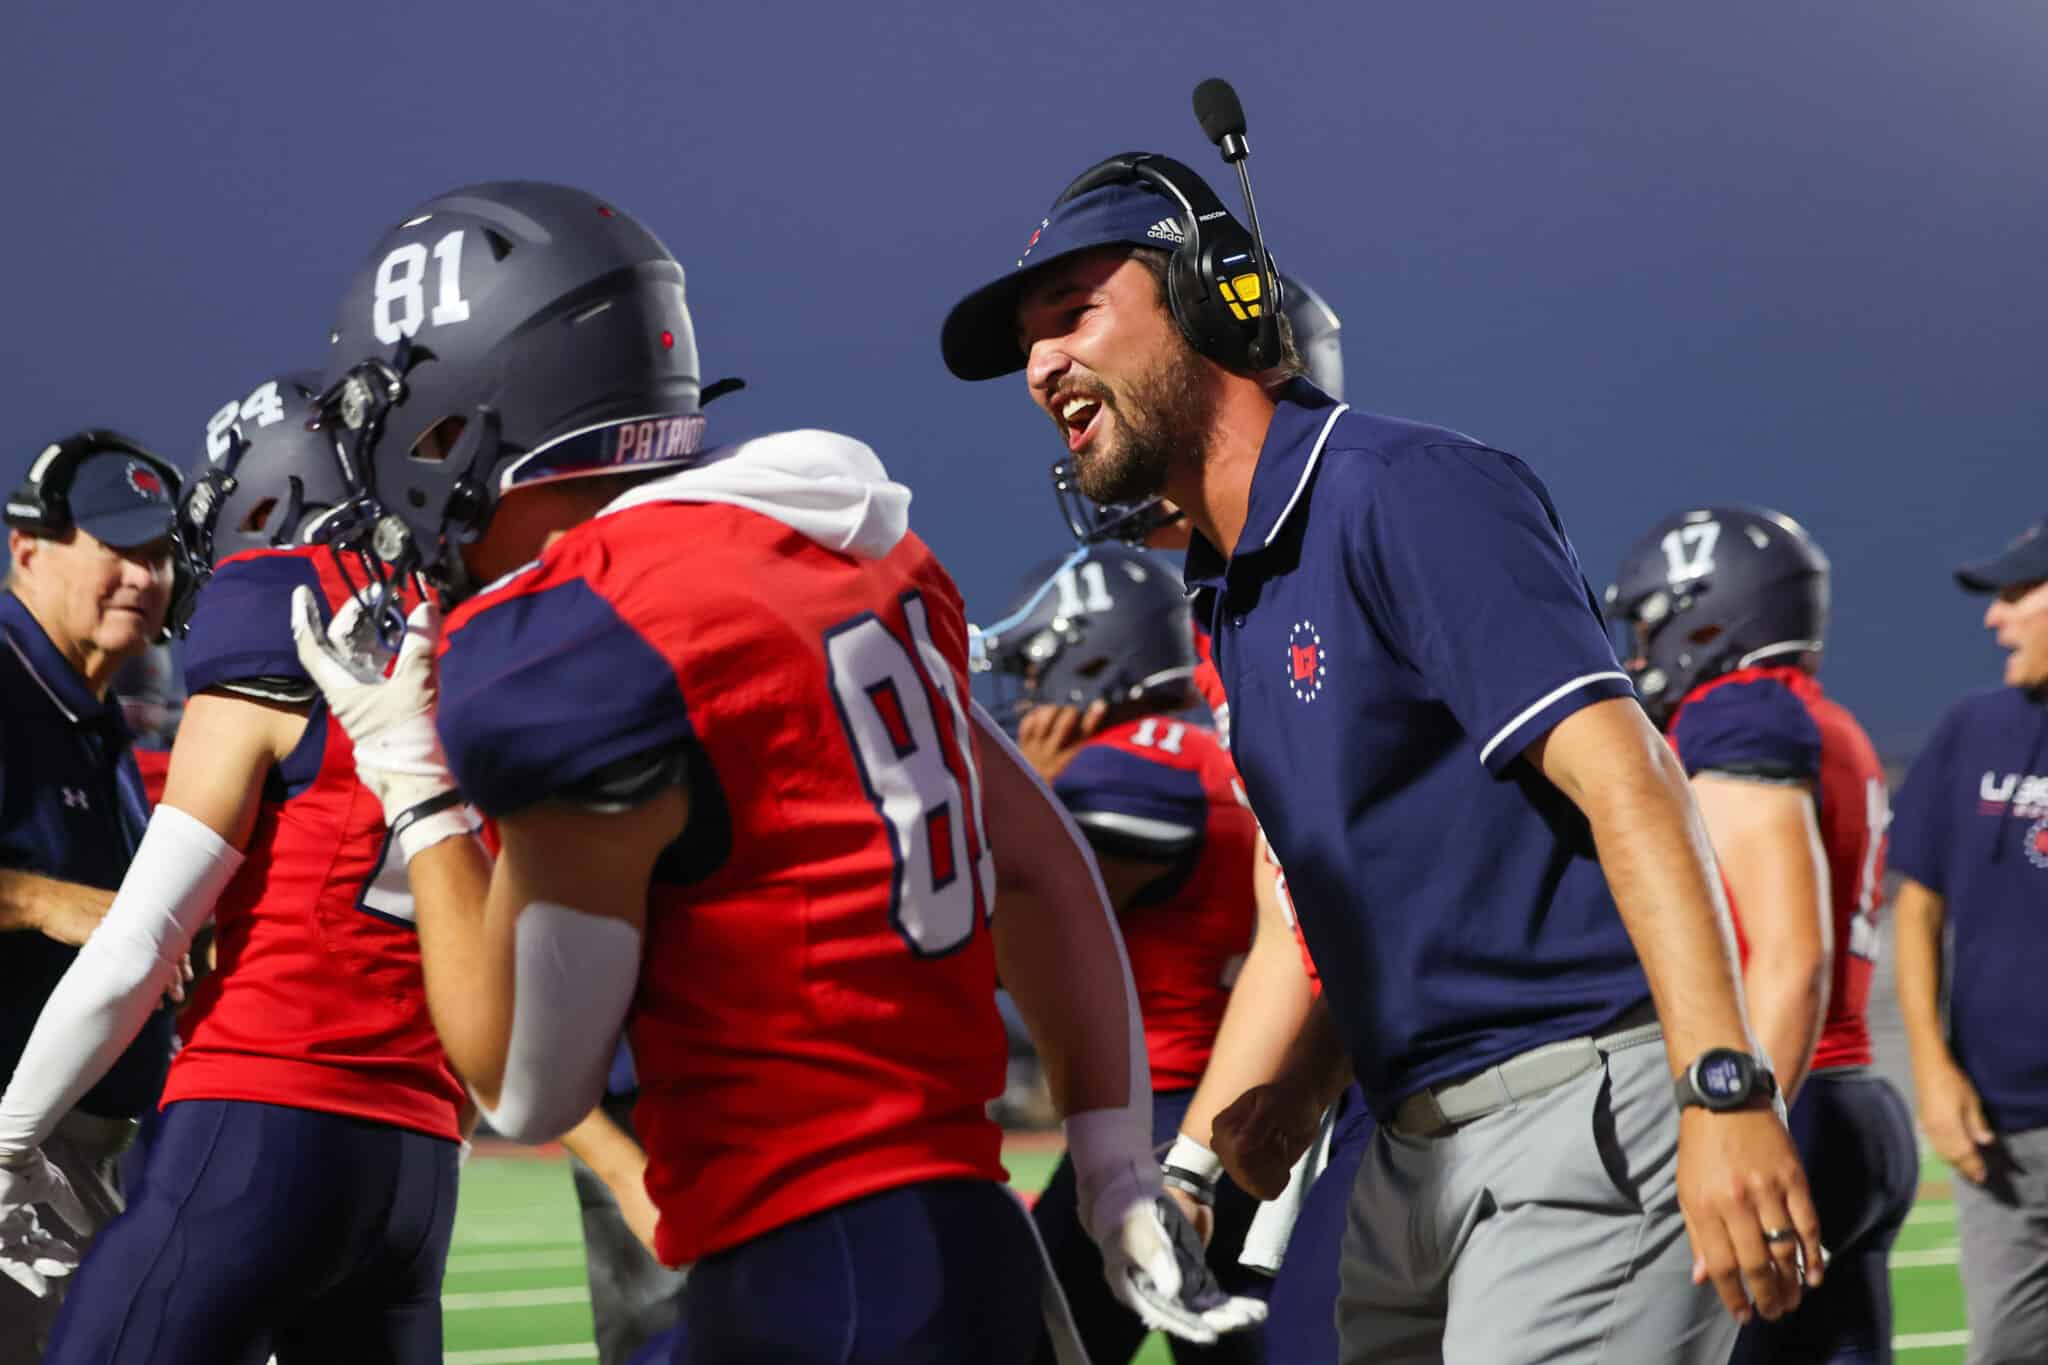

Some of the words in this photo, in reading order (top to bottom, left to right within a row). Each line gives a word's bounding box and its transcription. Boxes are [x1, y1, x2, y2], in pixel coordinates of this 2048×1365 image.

[373, 230, 470, 345] 81
[206, 380, 285, 462] 24
[1661, 520, 1721, 585] 17
[1057, 561, 1115, 618] 11
[1129, 717, 1186, 754] 11
